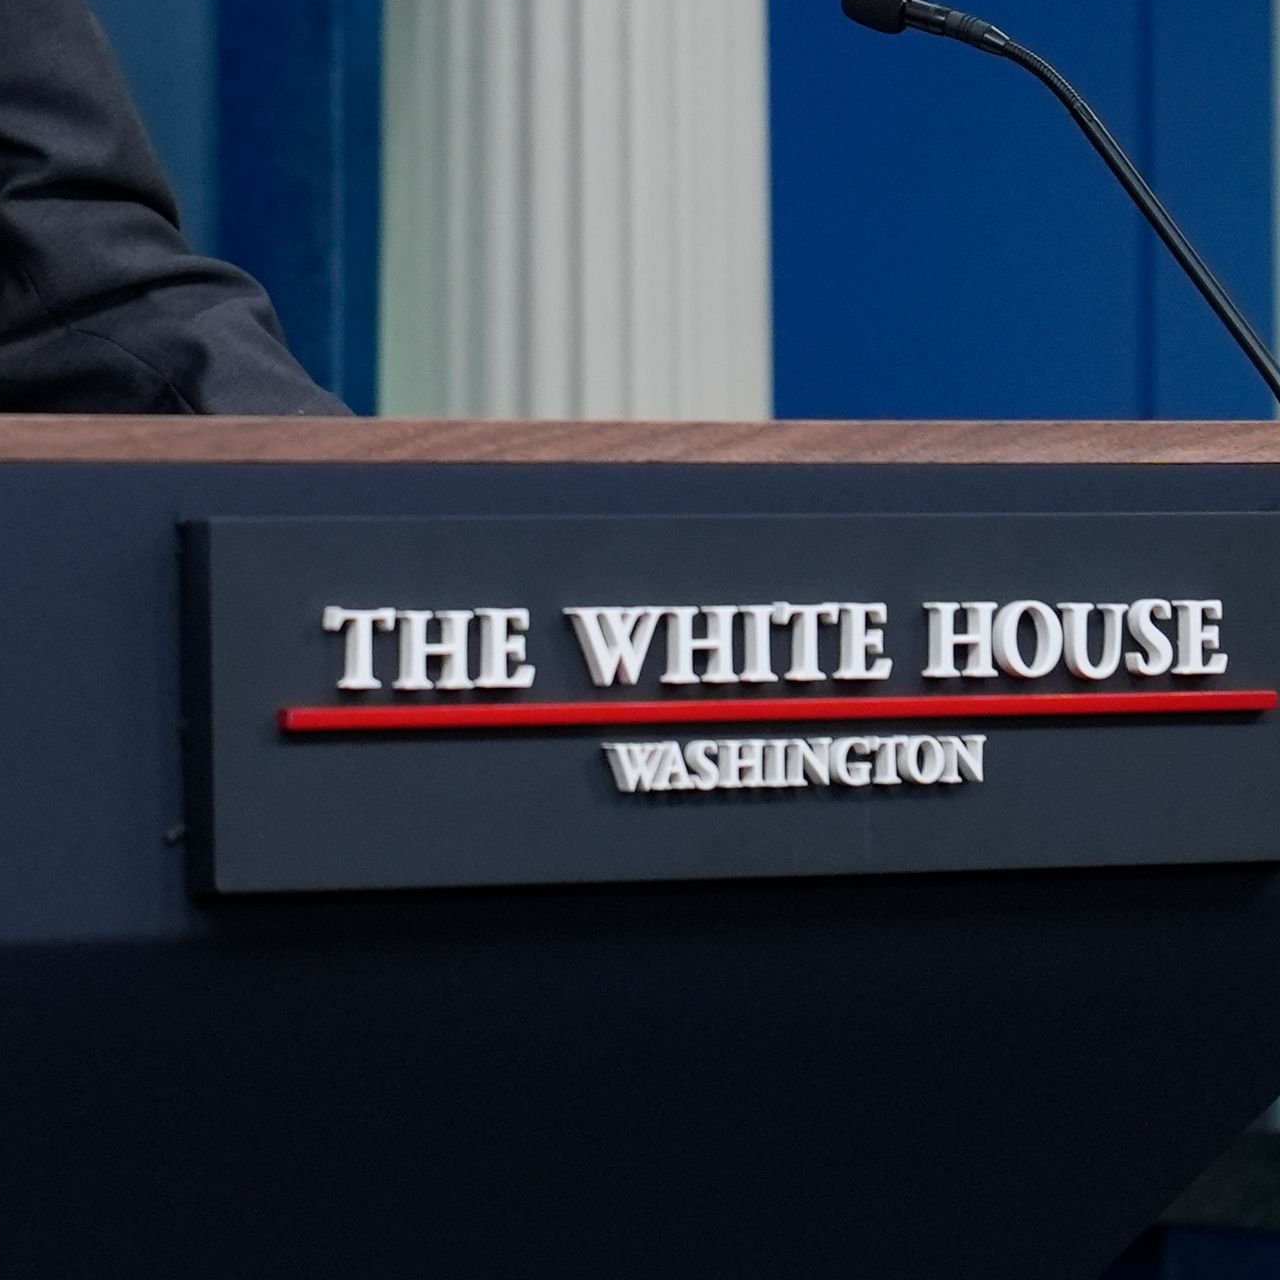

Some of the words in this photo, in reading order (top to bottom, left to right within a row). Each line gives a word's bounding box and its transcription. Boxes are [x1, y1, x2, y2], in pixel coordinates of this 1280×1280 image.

[322, 604, 537, 690] THE
[562, 600, 893, 687] WHITE
[921, 597, 1230, 680] HOUSE
[601, 733, 987, 793] WASHINGTON
